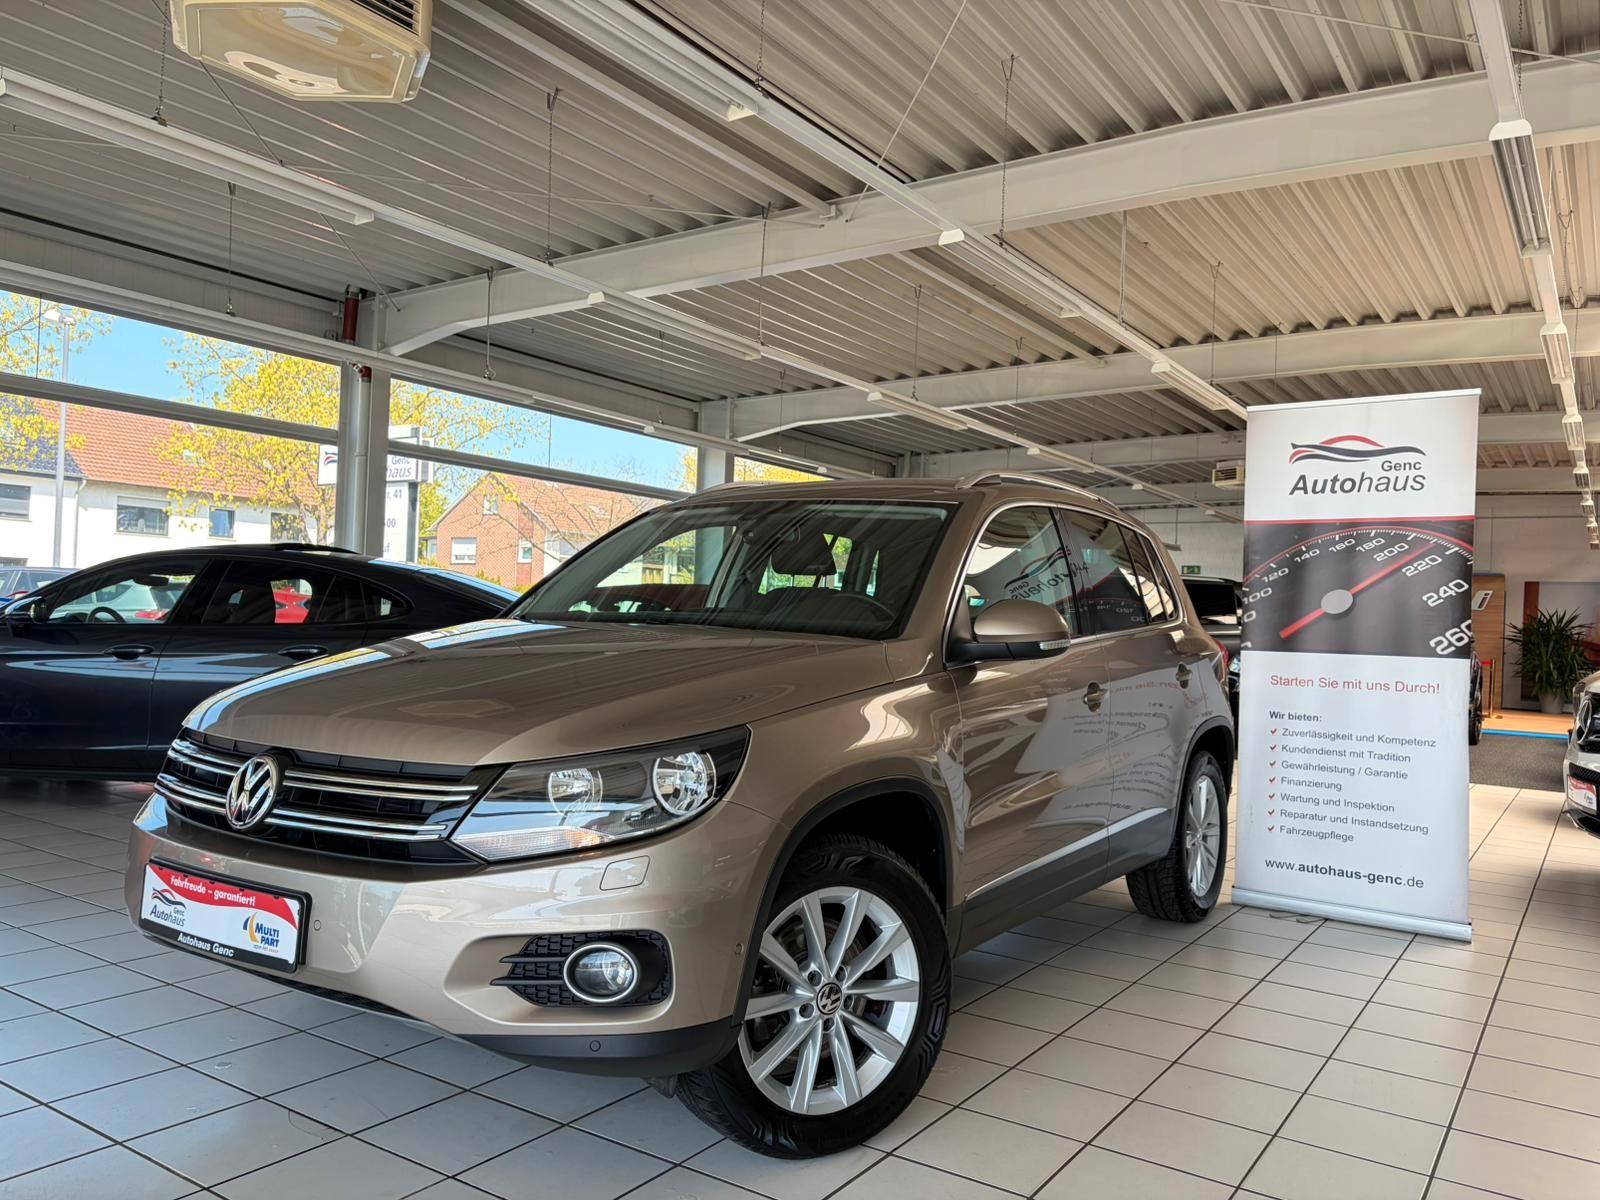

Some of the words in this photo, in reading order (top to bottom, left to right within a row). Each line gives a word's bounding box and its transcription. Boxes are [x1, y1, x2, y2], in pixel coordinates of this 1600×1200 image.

[1382, 460, 1422, 472] Genc
[1289, 472, 1426, 495] Autohaus
[393, 490, 402, 498] 41
[1329, 538, 1356, 552] 160
[1356, 538, 1385, 552] 180
[1374, 543, 1409, 562] 200
[1294, 549, 1320, 563] 140
[1261, 567, 1289, 582] 120
[1402, 555, 1442, 577] 220
[1423, 579, 1468, 608] 240
[1270, 675, 1314, 688] Starten
[1318, 677, 1338, 689] Sie
[1343, 679, 1362, 690] mit
[1366, 682, 1390, 692] uns
[1395, 681, 1440, 694] Durch!
[1269, 711, 1285, 720] Wir
[1288, 712, 1322, 722] bieten:
[1282, 728, 1352, 742] Zuverlässigkeit
[1356, 733, 1374, 742] und
[1378, 735, 1436, 748] Kompetenz
[1282, 745, 1346, 758] Kundendienst
[1350, 749, 1365, 759] mit
[1368, 751, 1411, 762] Tradition
[1281, 760, 1355, 776] Gewährleistung
[1365, 767, 1408, 779] Garantie
[1281, 777, 1342, 791] Finanzierung
[1280, 793, 1320, 807] Wartung
[1323, 798, 1340, 807] und
[1344, 799, 1395, 812] Inspektion
[1280, 809, 1327, 822] Reparatur
[1330, 815, 1348, 824] und
[1351, 817, 1429, 835] Instandsetzung
[1280, 826, 1354, 842] Fahrzeugpflege
[1265, 858, 1424, 888] www.autohaus-genc.de
[170, 875, 206, 894] Fahrfreude
[214, 888, 256, 906] garantiert!
[150, 904, 186, 927] Autohaus
[173, 907, 185, 916] Genc
[255, 922, 280, 937] MULTI
[177, 932, 211, 951] Autohaus
[213, 944, 234, 957] Genc
[261, 936, 280, 948] PART
